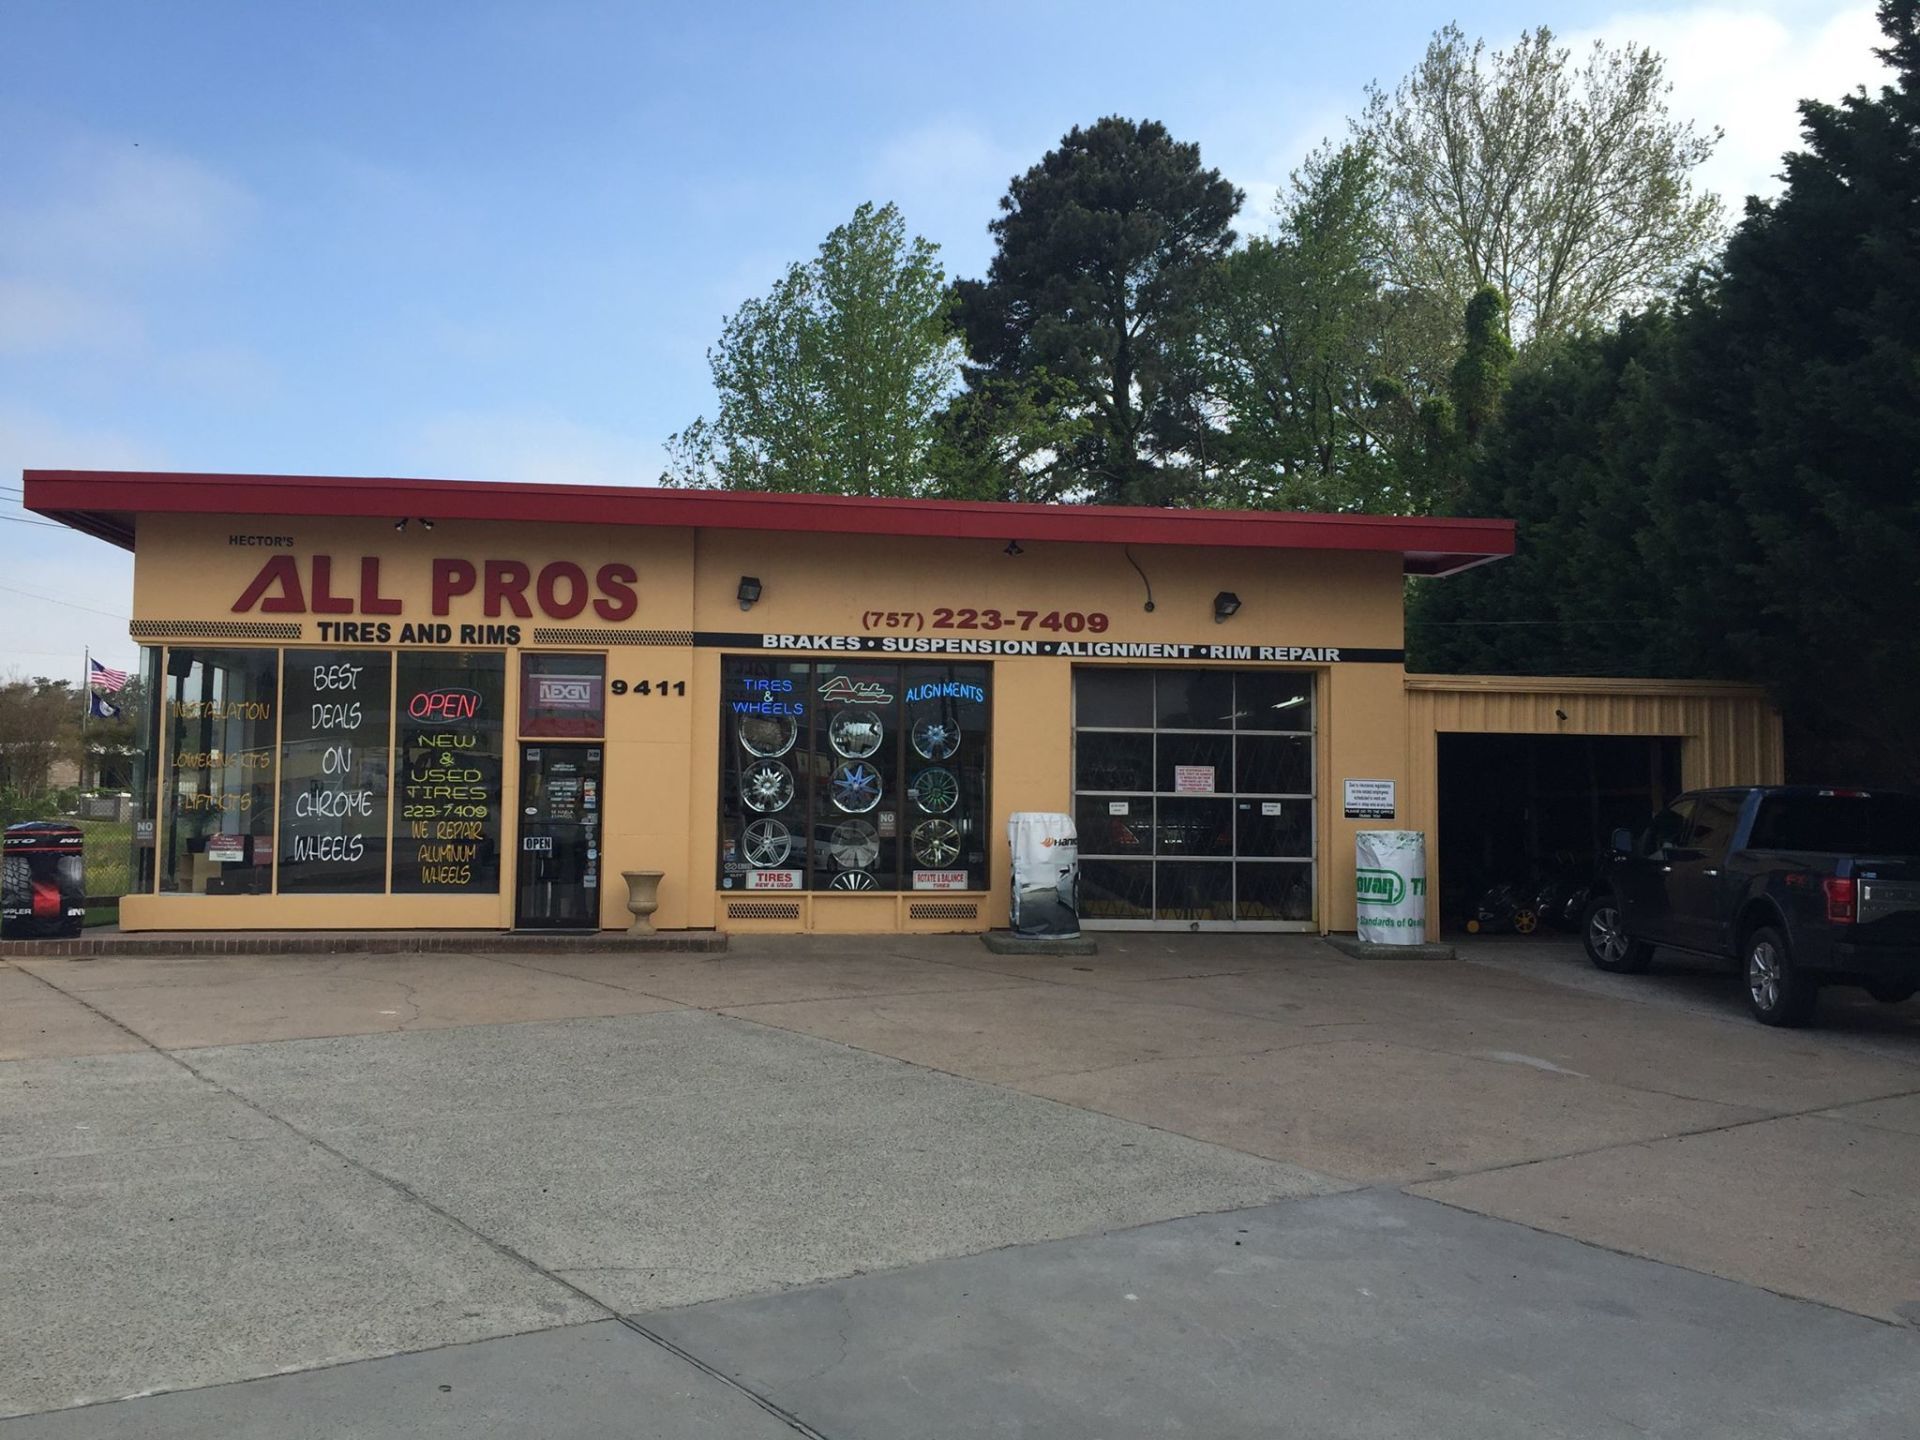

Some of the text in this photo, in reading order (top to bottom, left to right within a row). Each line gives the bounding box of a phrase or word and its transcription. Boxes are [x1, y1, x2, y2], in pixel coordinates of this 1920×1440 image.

[229, 534, 294, 548] HECTOR'S
[231, 554, 638, 622] ALL PROS
[862, 608, 1109, 634] (757) 223-7409
[317, 621, 521, 645] TIRES AND RIMS
[762, 634, 1341, 662] BRAKES SUSPENSION ALIGNMENT RIM REPAIR
[313, 662, 363, 691] BEST
[611, 680, 685, 697] 9411
[744, 679, 793, 693] TIRES
[905, 680, 985, 704] ALIGNMENTS
[410, 693, 478, 718] OPEN
[764, 691, 775, 704] &
[311, 702, 362, 730] DEALS
[732, 702, 805, 717] WHEELS
[417, 733, 476, 748] NEW
[322, 746, 351, 774] ON
[440, 751, 455, 767] &
[411, 769, 482, 783] USED
[406, 785, 488, 801] TIRES
[296, 789, 373, 818] CHROME
[403, 803, 488, 818] 223-7409
[138, 821, 154, 832] NO
[880, 813, 895, 823] NO
[412, 820, 429, 840] WE
[294, 833, 364, 862] WHEELS
[526, 839, 552, 849] OPEN
[422, 865, 471, 884] WHEELS
[757, 873, 792, 882] TIRES
